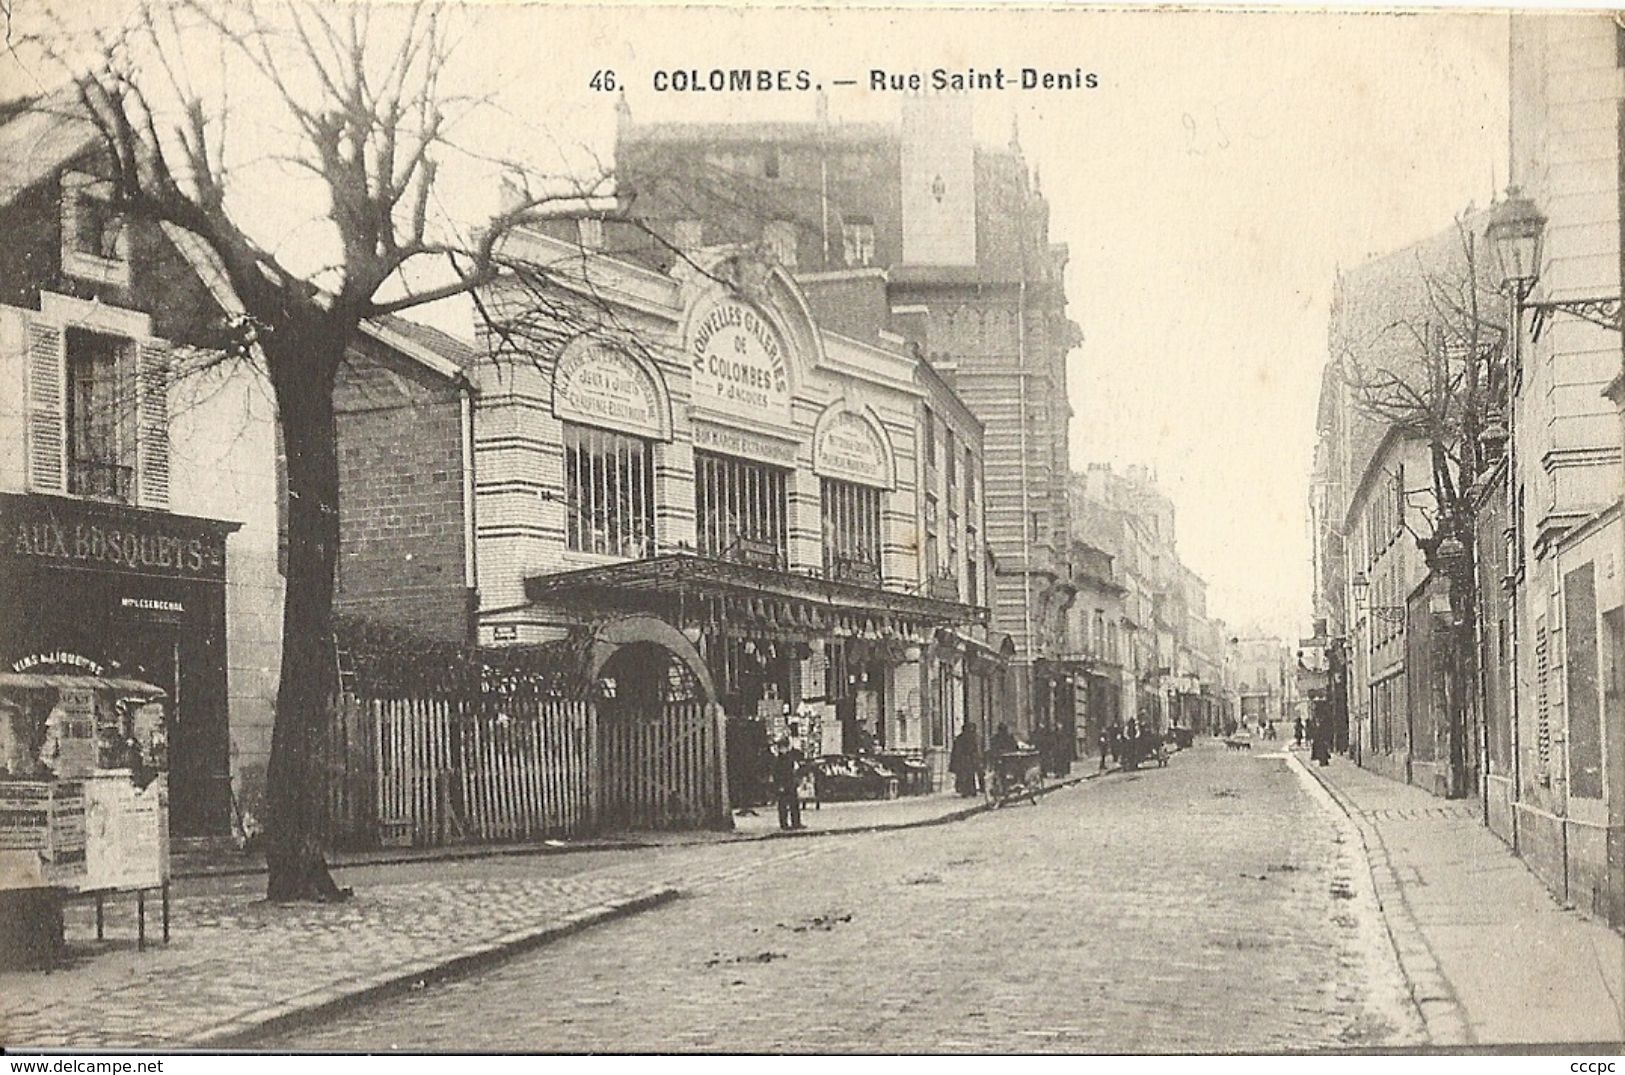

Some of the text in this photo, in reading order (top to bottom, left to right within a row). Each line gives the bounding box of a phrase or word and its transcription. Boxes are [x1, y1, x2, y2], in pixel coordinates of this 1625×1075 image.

[692, 305, 787, 394] NOUVELLES GALERIES
[734, 334, 747, 355] DE
[708, 354, 772, 390] COLOMBES
[15, 522, 69, 558] AUX
[11, 654, 39, 673] VINS
